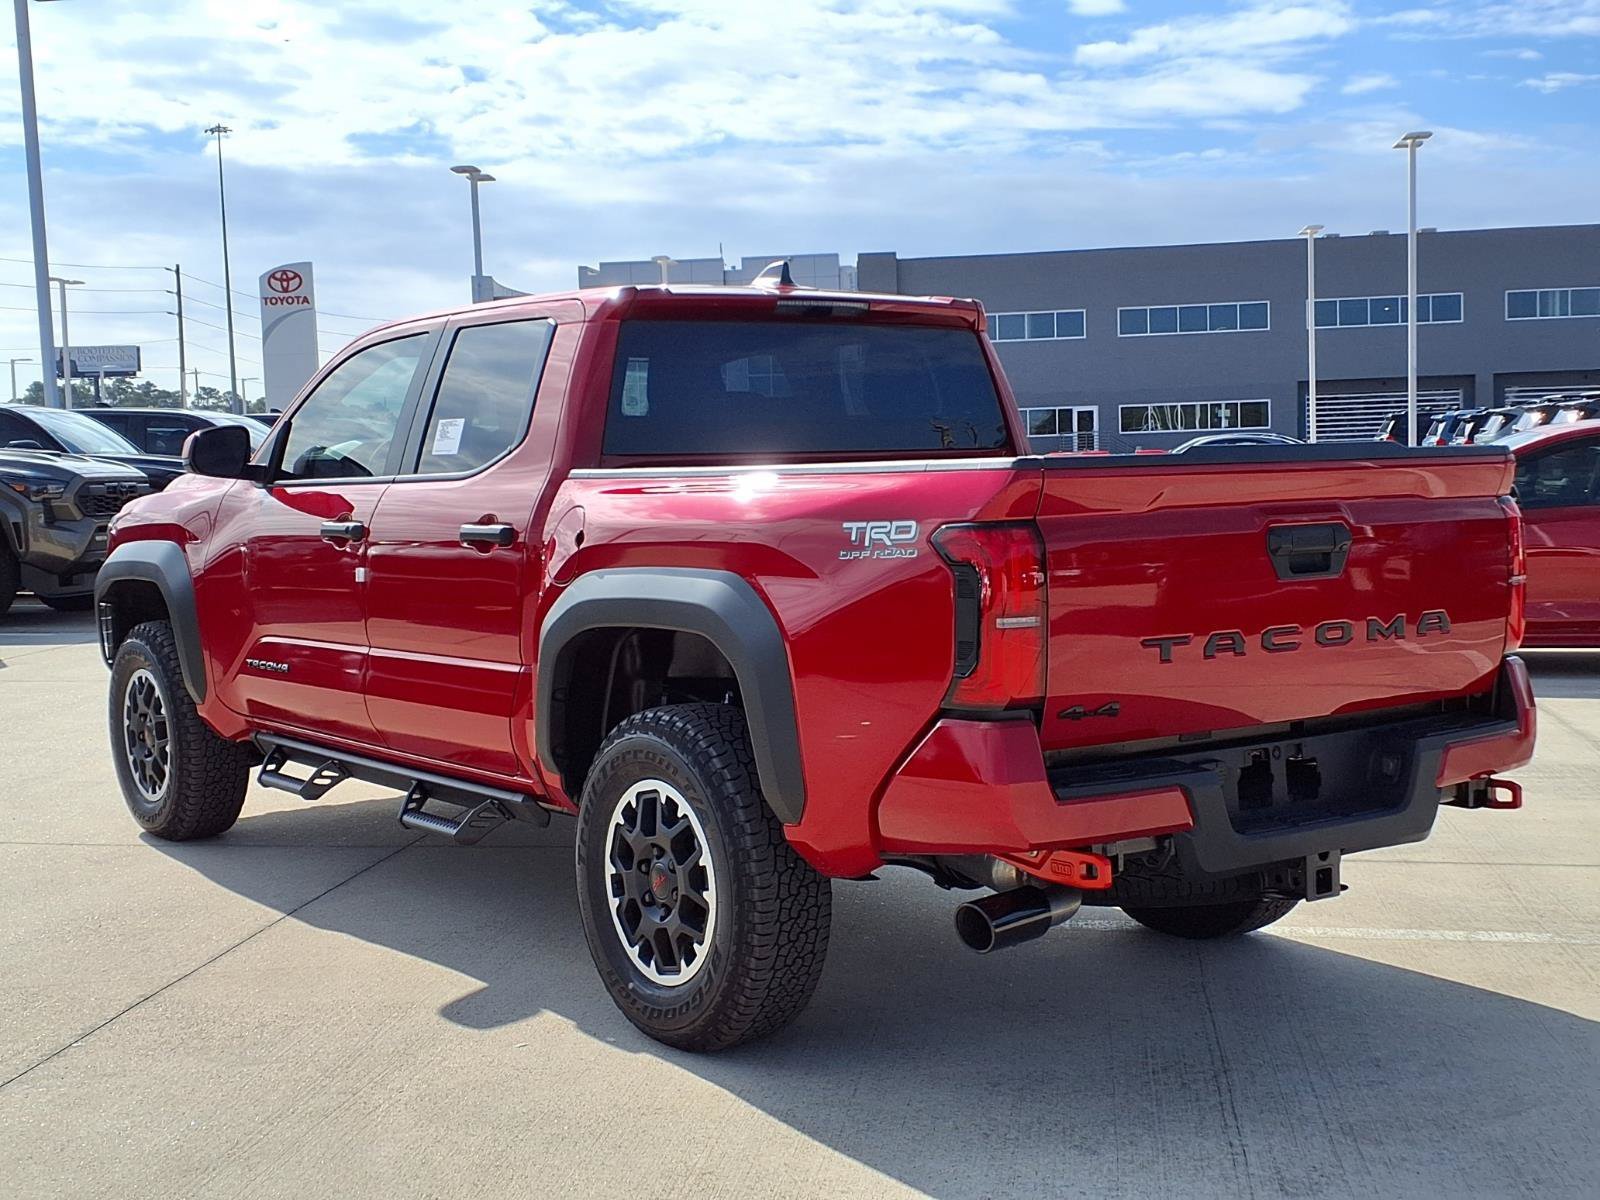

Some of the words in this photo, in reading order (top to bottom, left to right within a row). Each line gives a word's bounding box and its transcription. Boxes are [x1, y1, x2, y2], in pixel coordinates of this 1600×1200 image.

[262, 295, 310, 306] TOYOTA
[842, 520, 918, 548] TRD
[838, 550, 871, 560] OFF
[873, 548, 918, 559] ROAD
[1141, 609, 1451, 664] TACOMA
[245, 658, 288, 672] TACOMA
